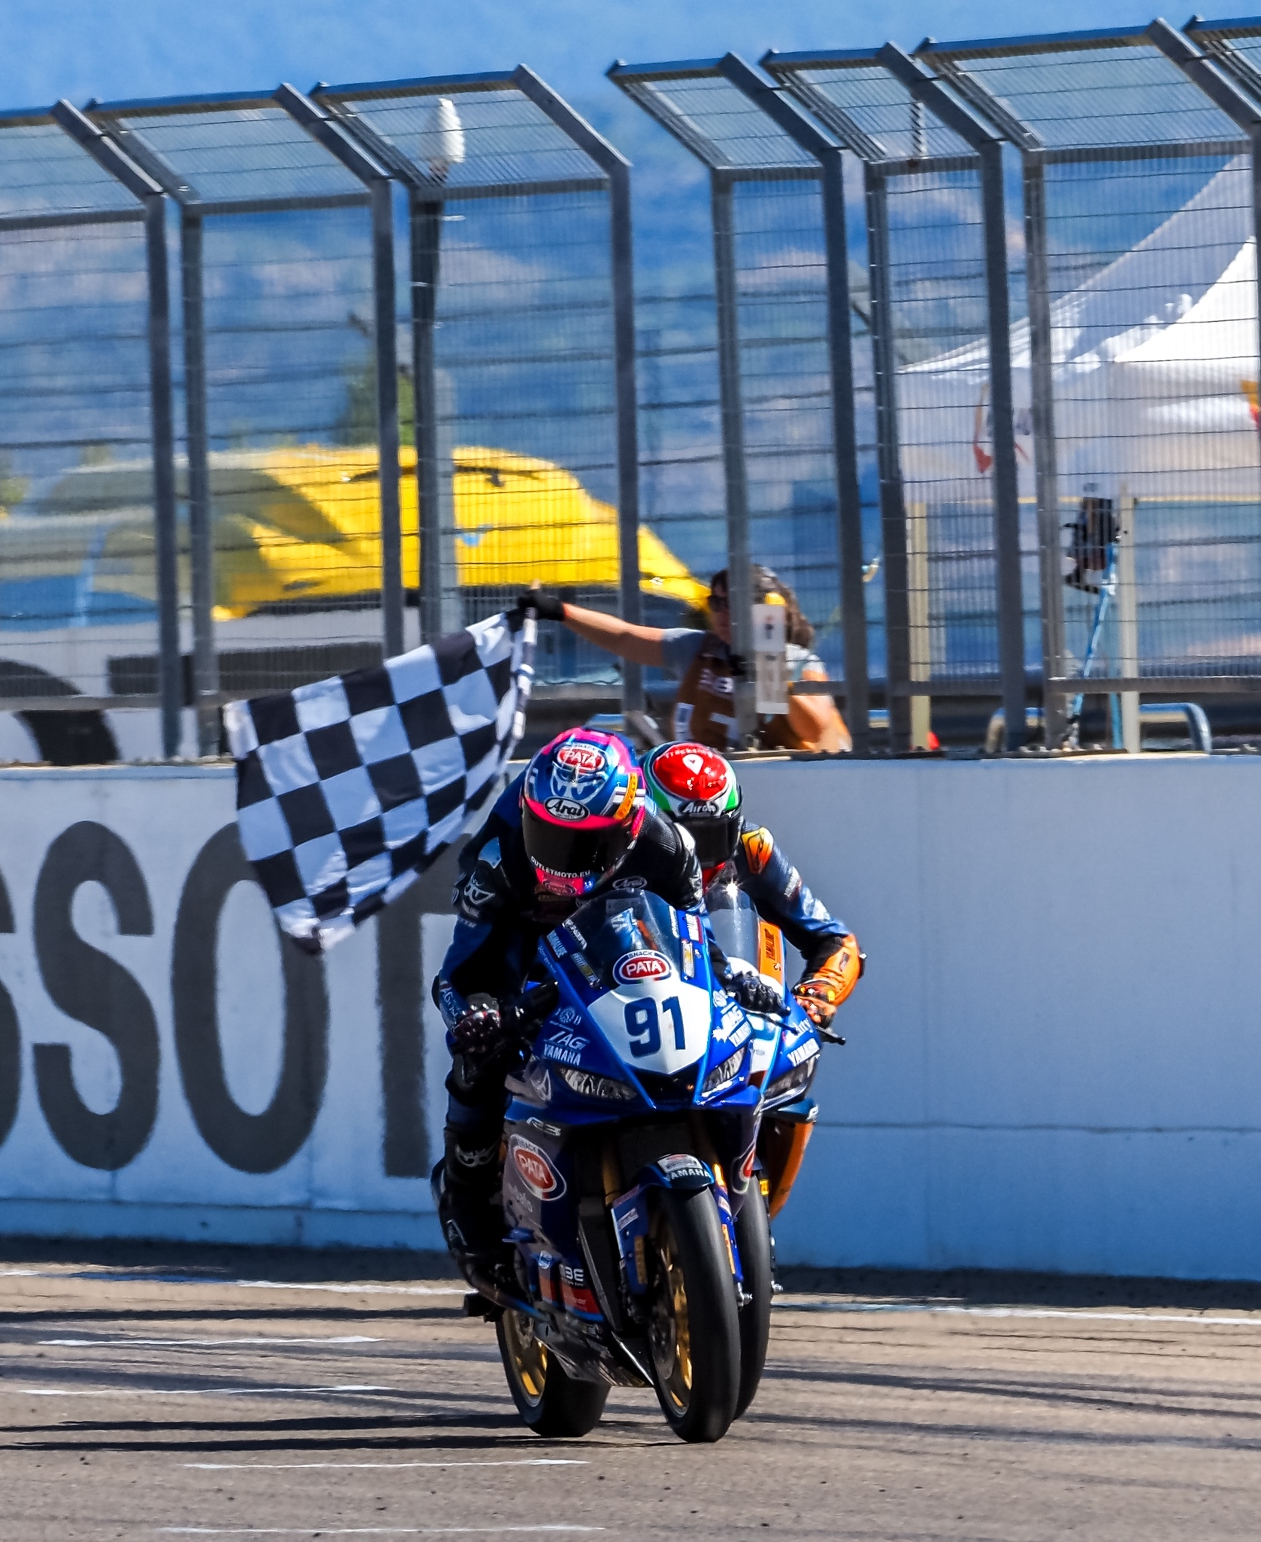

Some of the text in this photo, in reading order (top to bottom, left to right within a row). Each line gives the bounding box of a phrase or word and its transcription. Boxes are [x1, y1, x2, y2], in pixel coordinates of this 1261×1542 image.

[564, 751, 597, 767] PATA
[548, 800, 584, 816] Arai
[682, 801, 717, 813] Airoh
[530, 855, 591, 878] OUTLETMOTO.EU
[628, 950, 654, 958] SNACK
[625, 959, 663, 975] PATA
[623, 996, 687, 1060] 91
[543, 1043, 581, 1066] YAMAHA
[517, 1153, 549, 1184] PATA
